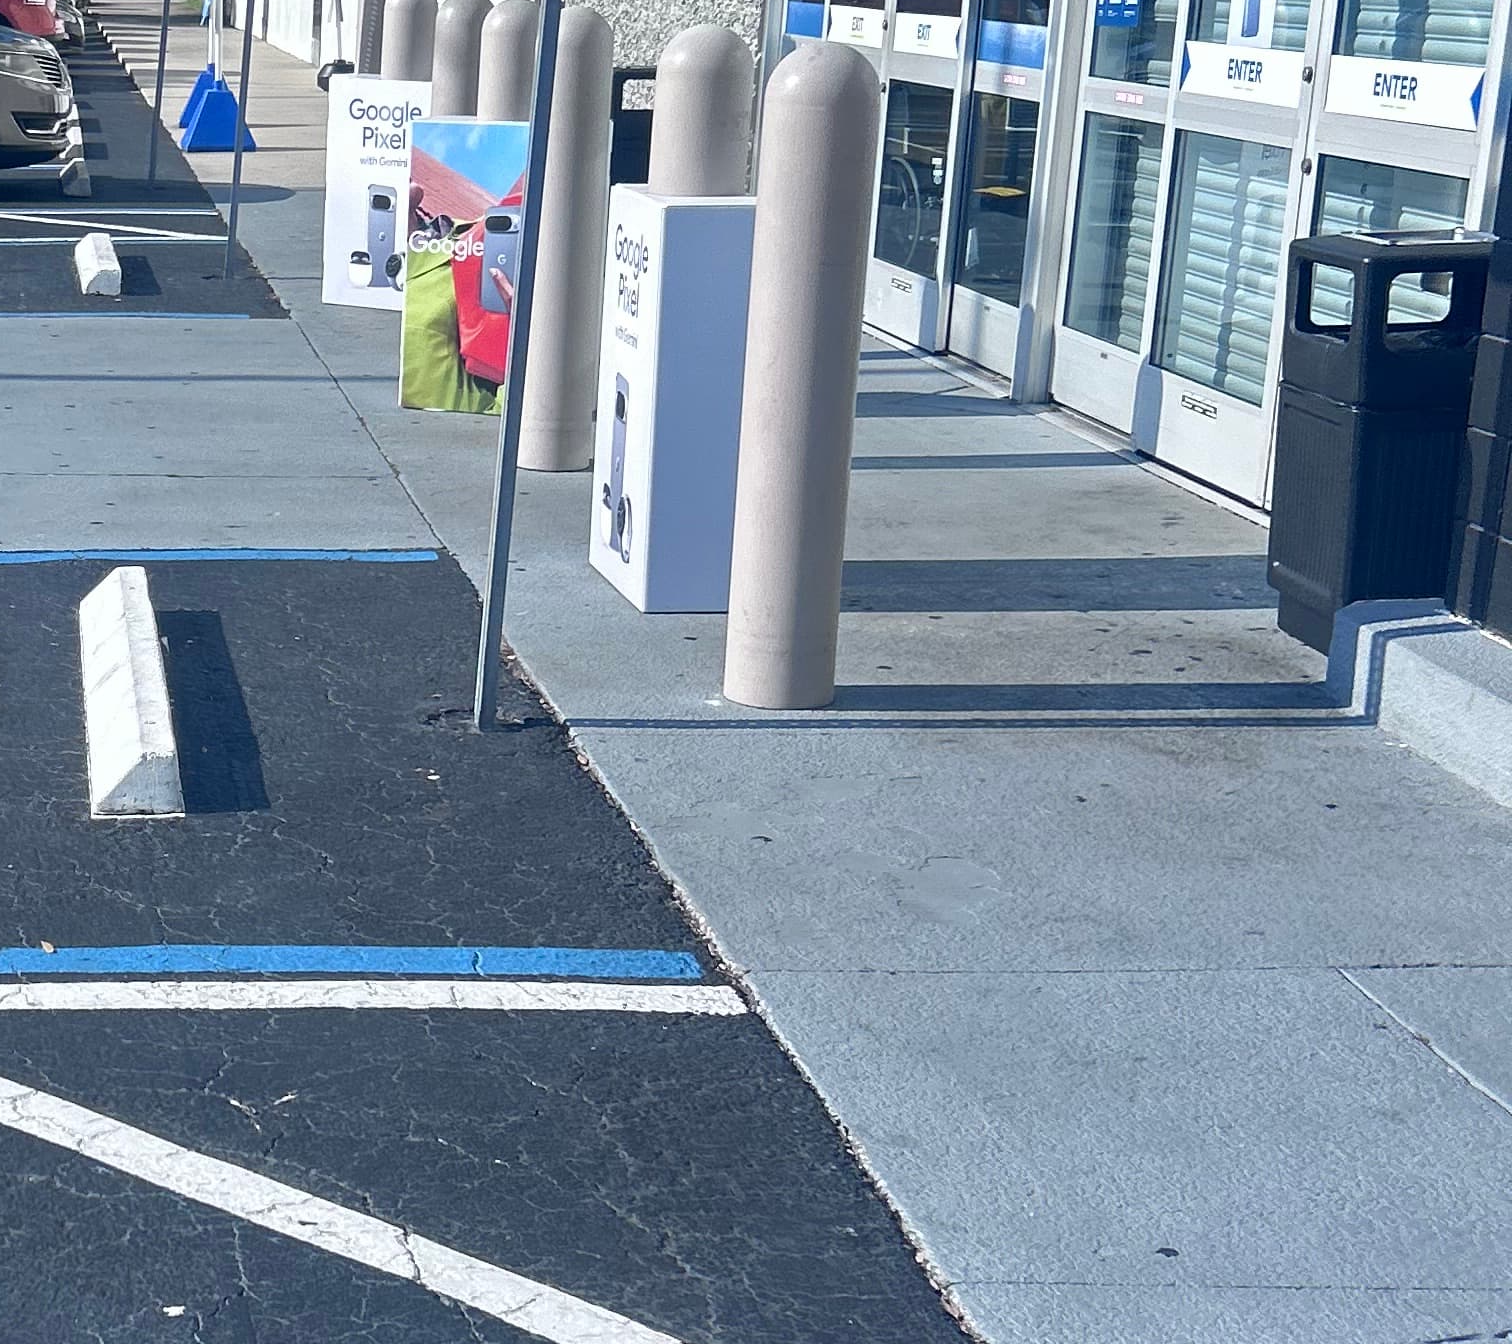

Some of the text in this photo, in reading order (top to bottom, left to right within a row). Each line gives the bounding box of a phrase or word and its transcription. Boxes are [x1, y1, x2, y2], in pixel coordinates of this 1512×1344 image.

[1227, 58, 1264, 84] ENTER
[1373, 72, 1419, 102] ENTER
[349, 98, 422, 128] Google
[362, 126, 406, 150] Pixel
[408, 230, 485, 262] Google
[615, 223, 649, 281] Google
[618, 272, 640, 319] Pixel
